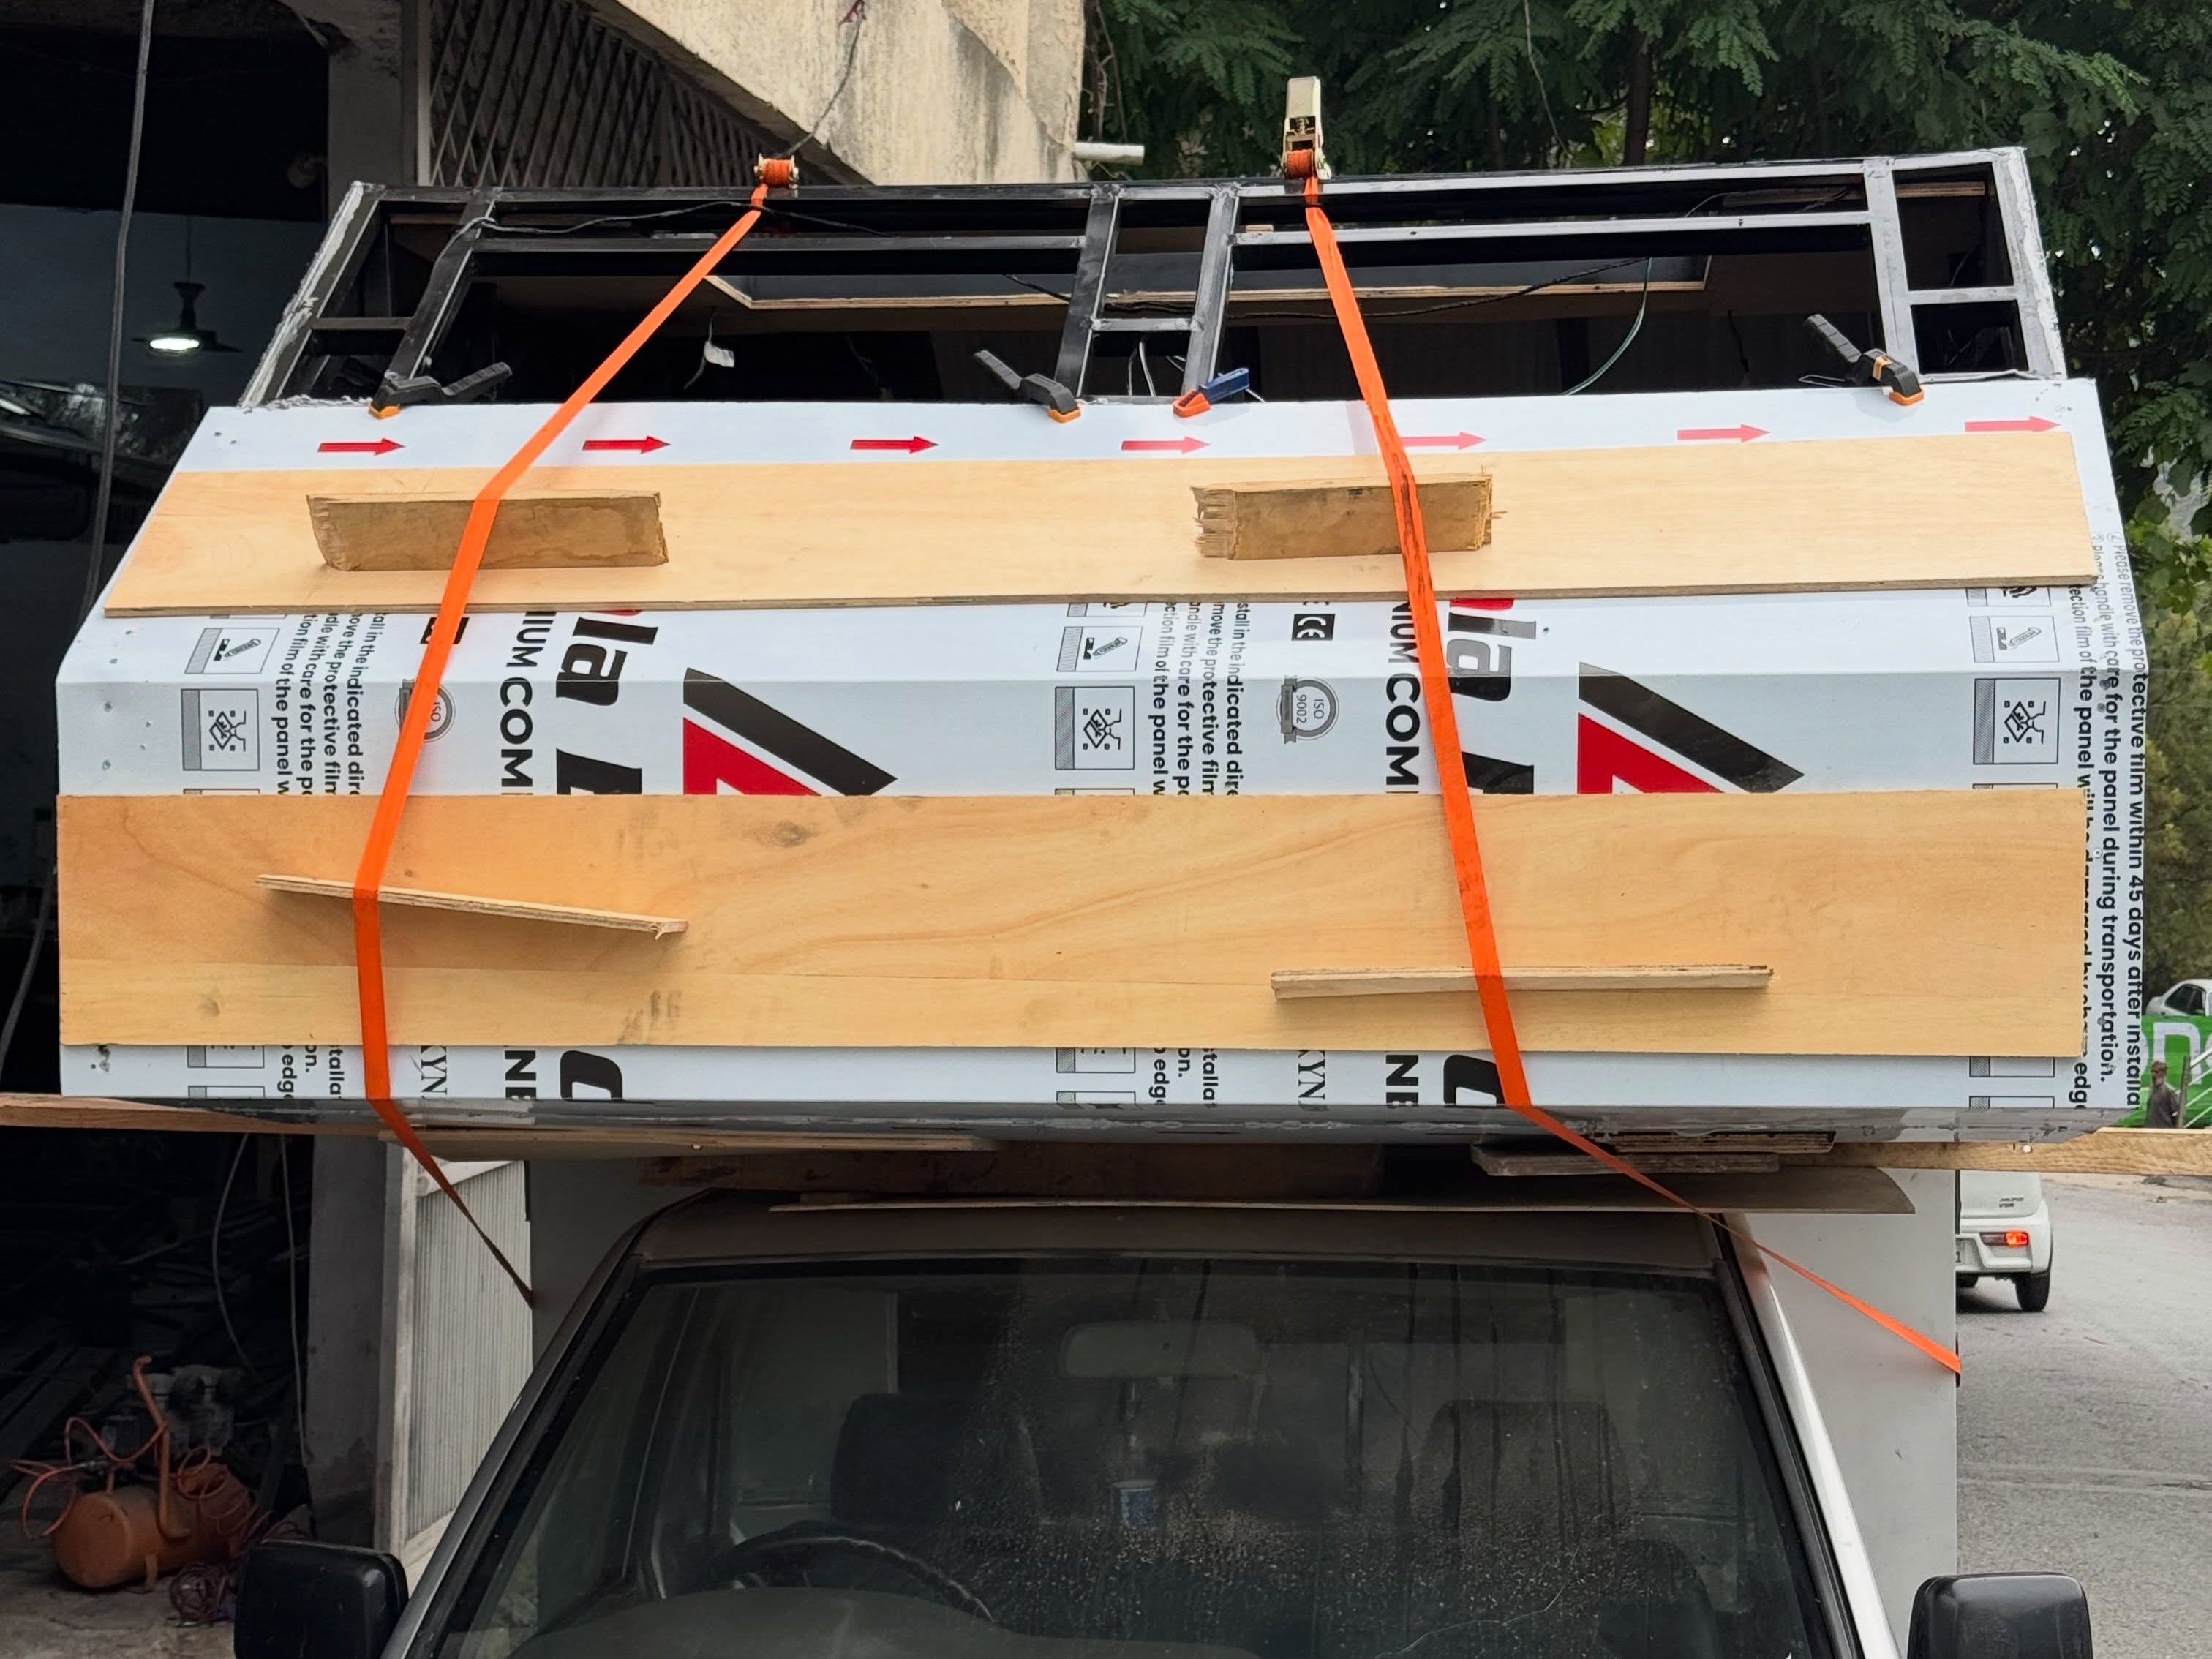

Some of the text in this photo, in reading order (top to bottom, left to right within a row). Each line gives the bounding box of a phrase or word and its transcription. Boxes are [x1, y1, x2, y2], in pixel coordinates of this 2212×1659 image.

[2095, 582, 2114, 621] handle
[2119, 582, 2139, 625] remove
[285, 638, 309, 661] film
[309, 635, 330, 661] with
[334, 640, 354, 660] the
[364, 630, 383, 642] in
[1157, 636, 1176, 658] film
[1181, 633, 1200, 658] with
[1205, 638, 1223, 657] the
[1230, 642, 1247, 661] the
[1233, 629, 1250, 640] in
[2075, 626, 2093, 648] film
[2101, 623, 2120, 648] with
[2128, 627, 2143, 646] the
[279, 663, 295, 676] of
[356, 644, 375, 664] the
[1154, 661, 1170, 672] of
[2079, 651, 2098, 663] of
[2106, 650, 2120, 688] care
[276, 677, 291, 712] the
[300, 663, 317, 699] care
[1153, 674, 1169, 710] the
[1178, 661, 1192, 696] care
[2080, 666, 2097, 701] the
[323, 661, 342, 756] protective
[347, 667, 369, 756] indicated
[1200, 659, 1219, 755] protective
[1226, 663, 1246, 755] indicated
[1295, 694, 1307, 724] 9002
[1313, 699, 1325, 719] ISO
[2104, 694, 2123, 723] for
[2125, 648, 2149, 748] protective
[300, 704, 316, 733] for
[1178, 701, 1194, 731] for
[1385, 673, 1421, 794] COM
[271, 716, 293, 776] panel
[500, 677, 533, 795] COM
[1148, 714, 1169, 775] panel
[1177, 735, 1193, 770] the
[2073, 707, 2095, 769] panel
[2104, 729, 2121, 764] the
[300, 737, 316, 772] the
[2129, 753, 2145, 795] film
[2098, 770, 2121, 832] panel
[2128, 801, 2144, 869] within
[2096, 837, 2121, 909] during
[2128, 875, 2143, 902] 45
[2122, 907, 2143, 961] days
[2096, 915, 2119, 1083] transportation.
[2126, 966, 2143, 1019] after
[277, 1054, 297, 1099] edg
[329, 1045, 345, 1099] talla
[2126, 1024, 2143, 1110] installa
[2069, 1062, 2091, 1109] edg
